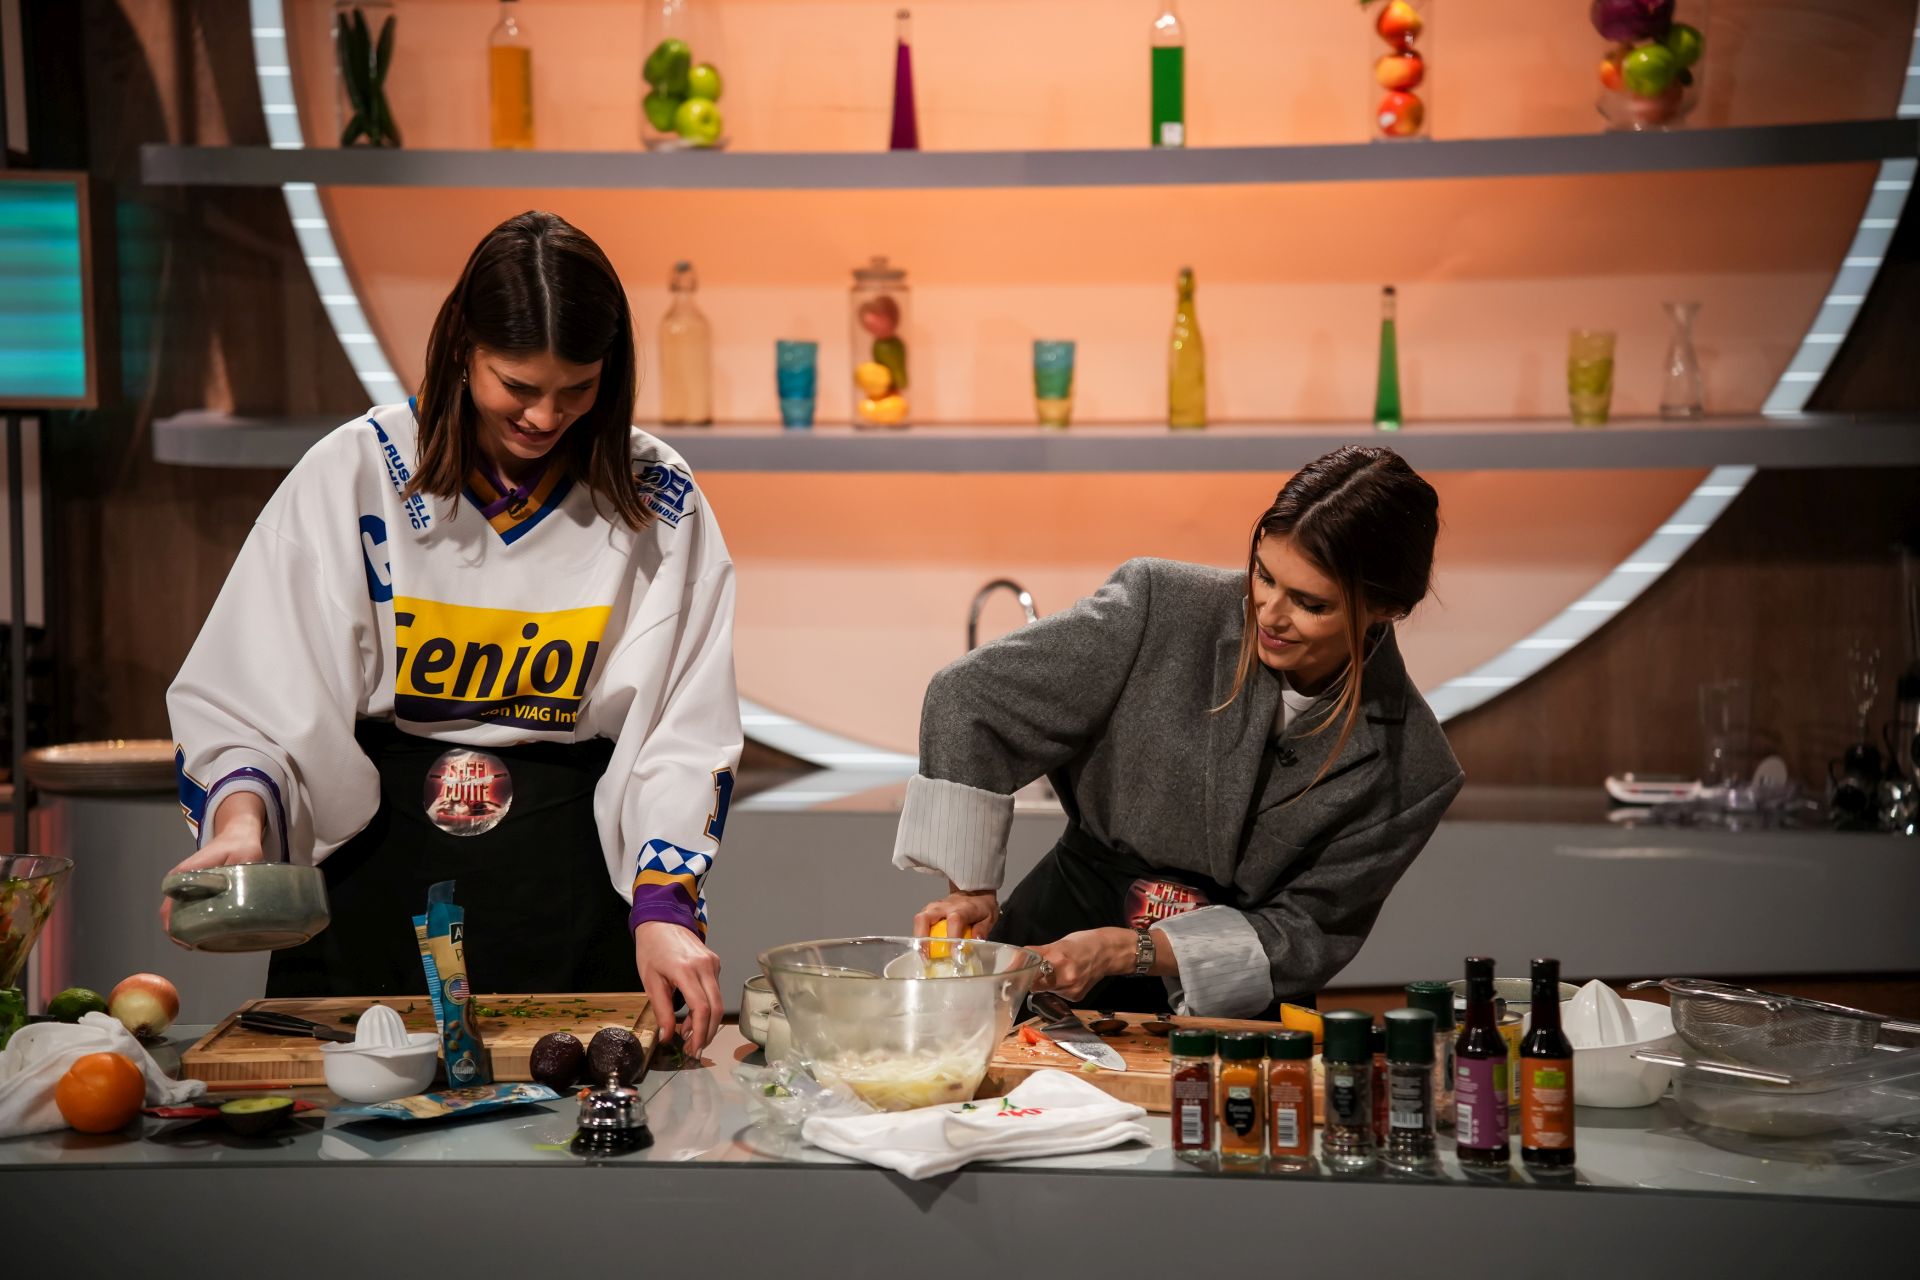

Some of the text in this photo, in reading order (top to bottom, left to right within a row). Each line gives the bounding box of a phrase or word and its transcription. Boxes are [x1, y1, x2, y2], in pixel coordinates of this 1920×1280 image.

[384, 444, 431, 528] RUSELL
[514, 704, 551, 722] VIAG
[555, 709, 577, 724] Int
[703, 766, 735, 847] 1
